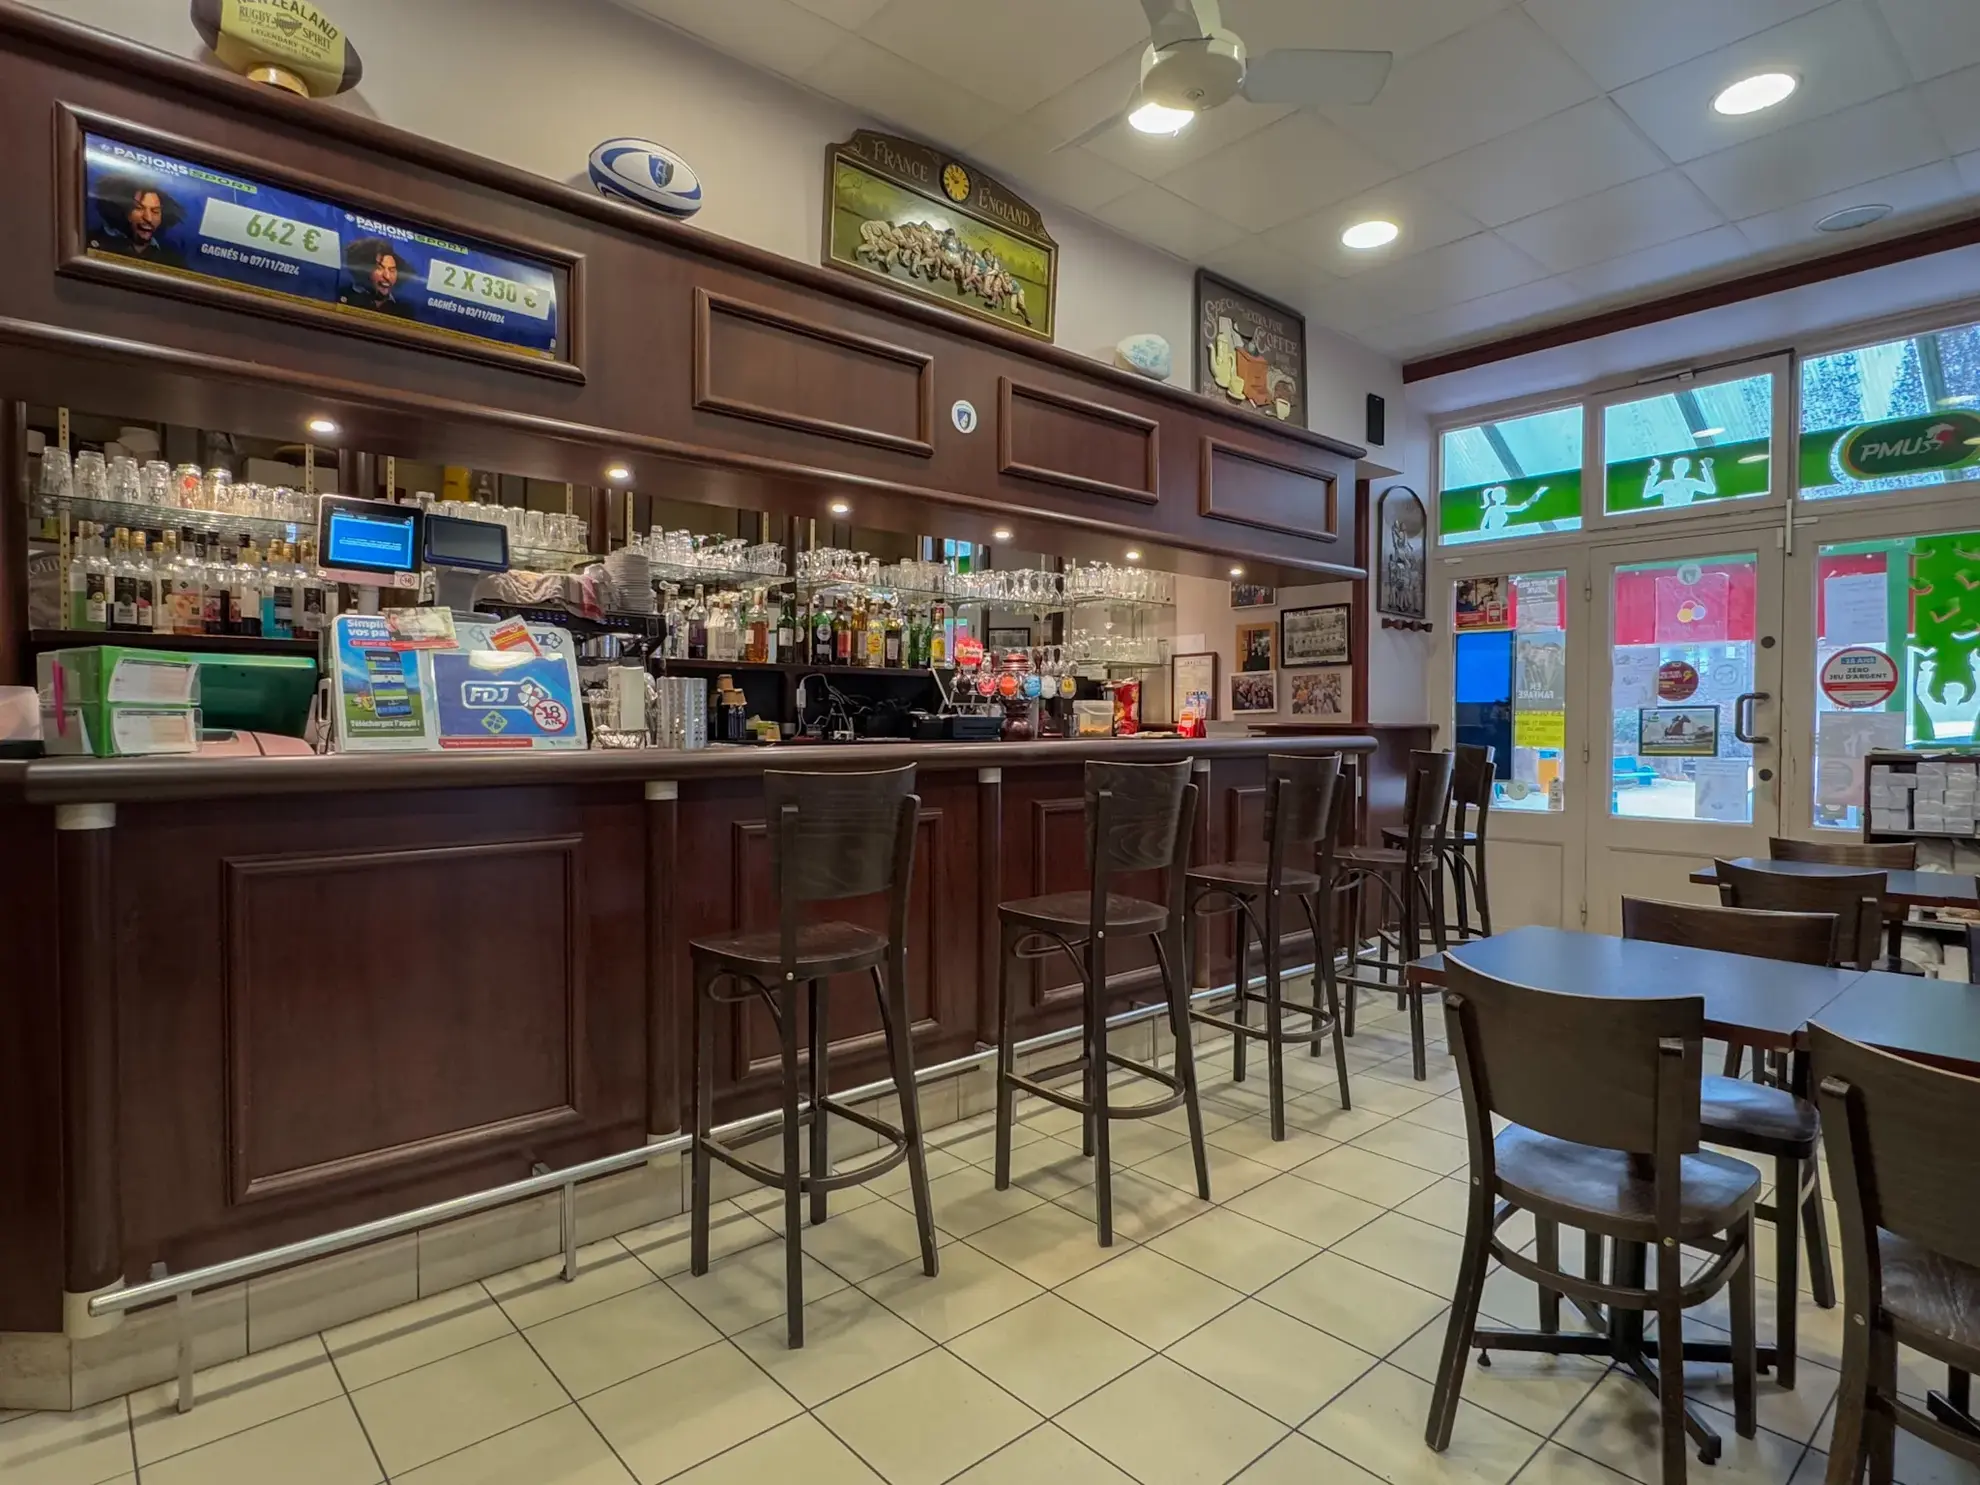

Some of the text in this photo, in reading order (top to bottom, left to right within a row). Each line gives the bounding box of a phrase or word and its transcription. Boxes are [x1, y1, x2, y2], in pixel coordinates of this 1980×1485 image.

[240, 6, 271, 23] RUGBY
[272, 0, 338, 40] ZEALAND
[251, 27, 297, 47] LEGENDARY
[302, 46, 321, 59] TEAM
[303, 26, 331, 50] SPIRIT
[113, 147, 257, 194] PARIONS SPORT
[872, 139, 929, 183] FRANCE
[978, 187, 1030, 227] ENGLAND
[246, 214, 321, 253] 642 €
[356, 216, 468, 255] PARIONS SPORT
[201, 243, 300, 276] GAGNÉS le 07/11/2024
[444, 266, 538, 309] 2 X 330 €
[427, 297, 458, 312] GAGNÉS
[465, 306, 506, 324] 03/11/2024
[1253, 325, 1298, 356] COFFEE
[1860, 436, 1922, 462] PMU
[347, 618, 386, 630] Simpli
[347, 629, 369, 637] vos
[1847, 666, 1869, 674] ZÉRO
[470, 687, 509, 703] FDJ
[536, 705, 561, 720] -18
